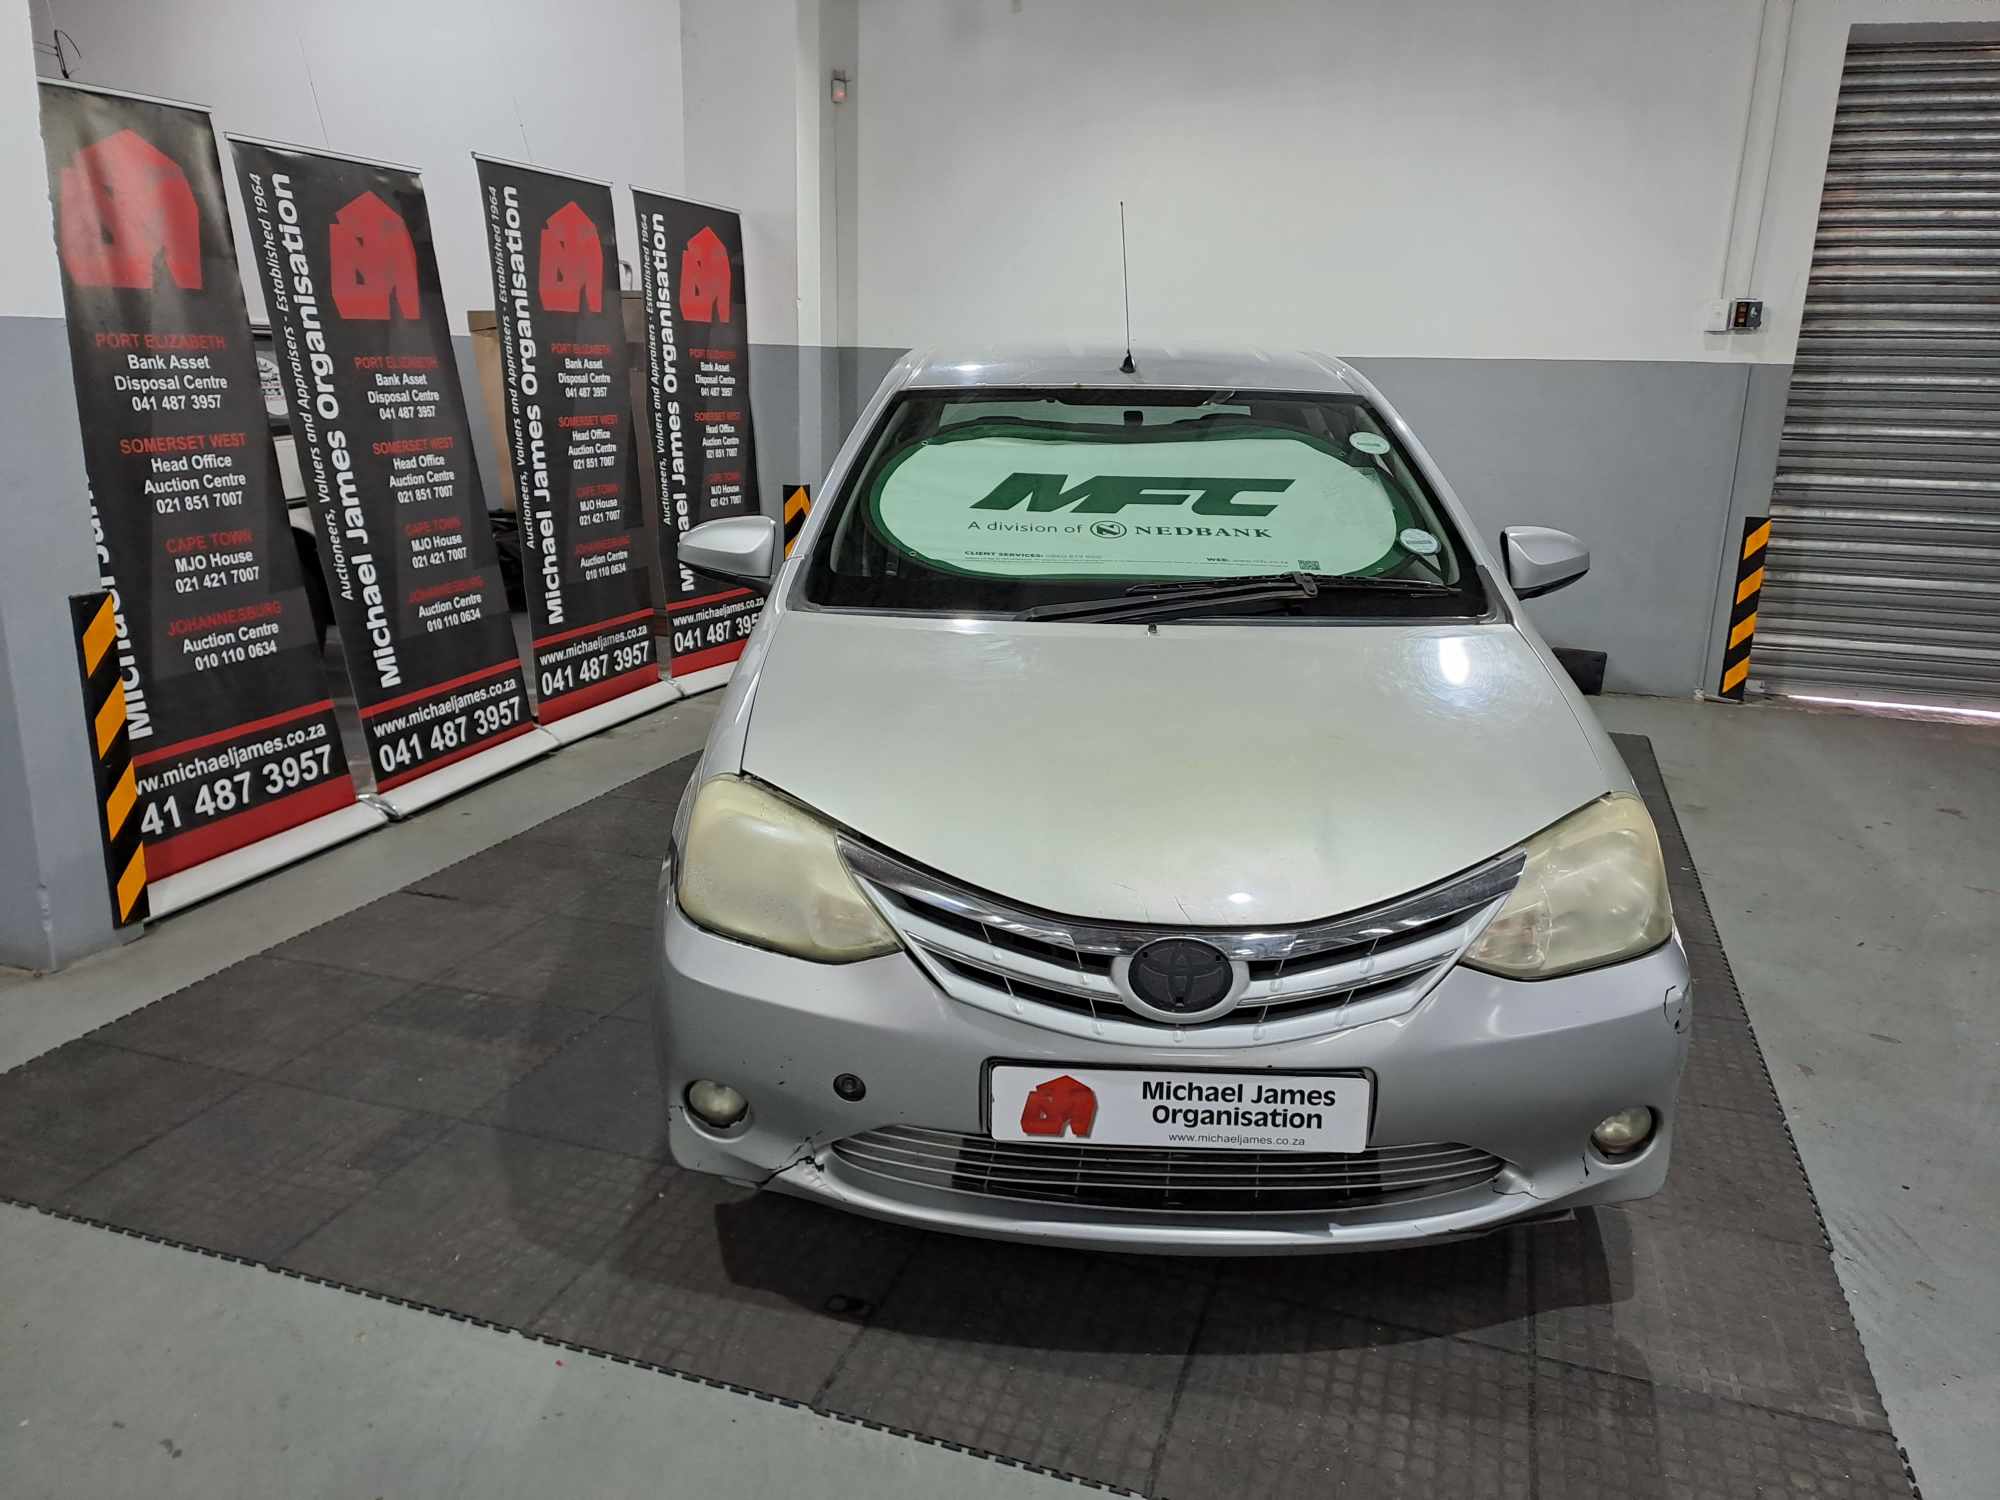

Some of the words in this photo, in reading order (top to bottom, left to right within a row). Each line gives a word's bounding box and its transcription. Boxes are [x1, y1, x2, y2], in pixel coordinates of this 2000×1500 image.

[250, 173, 269, 214] 1964
[489, 186, 500, 220] 1964
[258, 218, 289, 312] Established
[492, 224, 508, 303] Established
[272, 174, 339, 419] Organisation
[504, 186, 538, 396] Organisation
[652, 213, 677, 393] Organisation
[95, 333, 139, 348] PORT
[502, 315, 517, 389] Appraisers
[128, 354, 166, 369] Bank
[170, 355, 210, 369] Asset
[284, 326, 311, 407] Appraisers
[114, 376, 180, 393] Disposal
[184, 376, 228, 389] Centre
[376, 374, 400, 386] Bank
[403, 373, 427, 384] Asset
[132, 397, 157, 411] 041
[162, 396, 185, 410] 487
[192, 395, 221, 409] 3957
[368, 391, 409, 405] Disposal
[412, 390, 439, 401] Centre
[511, 389, 521, 414] and
[650, 386, 661, 414] and
[300, 411, 318, 443] and
[380, 408, 395, 420] 041
[398, 407, 414, 418] 487
[417, 406, 436, 417] 3957
[120, 435, 205, 454] SOMERSET
[210, 433, 248, 447] WEST
[516, 419, 525, 465] Valuers
[654, 412, 665, 453] Valuers
[668, 401, 686, 485] James
[151, 457, 188, 473] Head
[191, 454, 232, 468] Office
[393, 457, 416, 470] Head
[419, 454, 445, 466] Office
[527, 405, 550, 501] James
[568, 445, 594, 455] Auction
[573, 459, 585, 469] 021
[144, 477, 199, 494] Auction
[203, 473, 246, 488] Centre
[310, 447, 331, 502] Valuers
[328, 430, 368, 544] James
[390, 474, 425, 488] Auction
[427, 471, 455, 482] Centre
[156, 498, 180, 513] 021
[185, 497, 209, 510] 851
[214, 491, 243, 507] 7007
[397, 490, 413, 503] 021
[415, 488, 432, 501] 851
[433, 485, 453, 498] 7007
[968, 472, 1296, 517] MFC
[165, 535, 208, 553] CAPE
[411, 538, 432, 552] MJO
[434, 535, 462, 547] House
[673, 493, 694, 591] Mael
[968, 521, 980, 529] A
[987, 521, 1061, 533] division
[1066, 524, 1082, 533] of
[1136, 525, 1271, 538] NEDBANK
[175, 556, 206, 573] MJO
[211, 551, 253, 568] House
[326, 509, 354, 600] Auctioneers,
[412, 556, 428, 568] 021
[430, 552, 445, 564] 421
[447, 547, 467, 560] 7007
[537, 510, 563, 625] Michael
[175, 578, 199, 593] 021
[203, 573, 227, 588] 421
[231, 567, 260, 583] 7007
[419, 602, 452, 618] Auction
[454, 594, 482, 608] Centre
[427, 620, 442, 632] 010
[444, 615, 458, 626] 110
[460, 608, 480, 623] 0634
[673, 597, 764, 626] www.michaeljames.co.za
[352, 554, 401, 688] Michael
[674, 628, 701, 652] 041
[707, 620, 731, 643] 487
[736, 613, 761, 636] 395
[183, 632, 235, 654] Auction
[238, 623, 279, 641] Centre
[540, 625, 647, 666] www.michaeljames.co.za
[195, 656, 219, 671] 010
[222, 649, 245, 664] 110
[248, 640, 277, 659] 0634
[542, 665, 574, 696] 041
[580, 654, 609, 681] 487
[614, 640, 649, 671] 3957
[373, 678, 516, 738] www.michaeljames.co.za
[379, 733, 423, 772] 041
[430, 716, 467, 751] 487
[474, 696, 520, 735] 3957
[141, 796, 182, 835] 41
[195, 772, 251, 816] 487
[262, 744, 332, 794] 3957
[1142, 1081, 1243, 1103] Michael
[1251, 1085, 1336, 1106] James
[1153, 1105, 1322, 1129] Organisation
[1168, 1133, 1304, 1146] www.michaeljames.co.za
